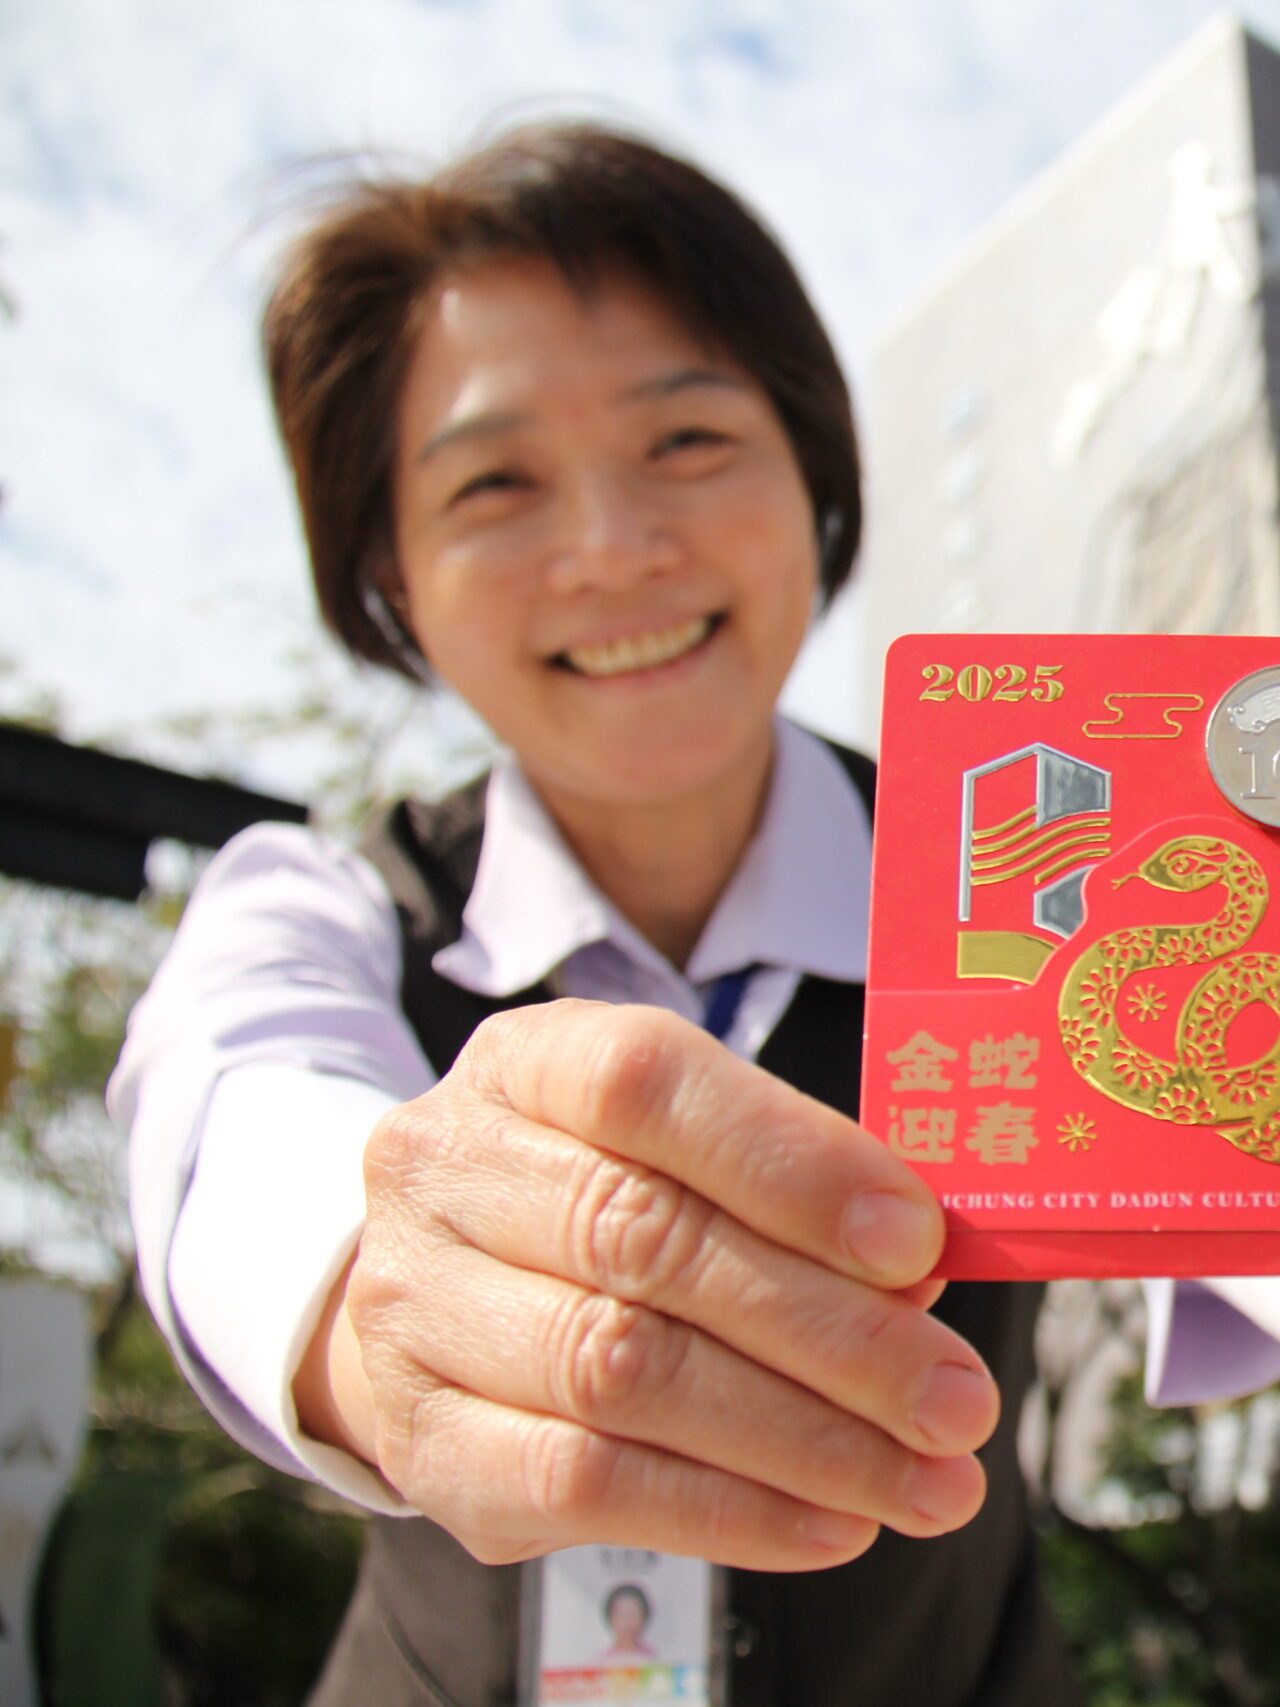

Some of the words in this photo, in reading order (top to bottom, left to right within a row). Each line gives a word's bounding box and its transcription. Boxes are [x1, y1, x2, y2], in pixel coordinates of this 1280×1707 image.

[919, 664, 1064, 702] 2025
[886, 1030, 1040, 1093] 金蛇
[888, 1101, 1040, 1165] 迎春
[942, 1191, 1034, 1209] ICHUNG
[1043, 1191, 1100, 1209] CITY
[1110, 1191, 1194, 1209] DADUN
